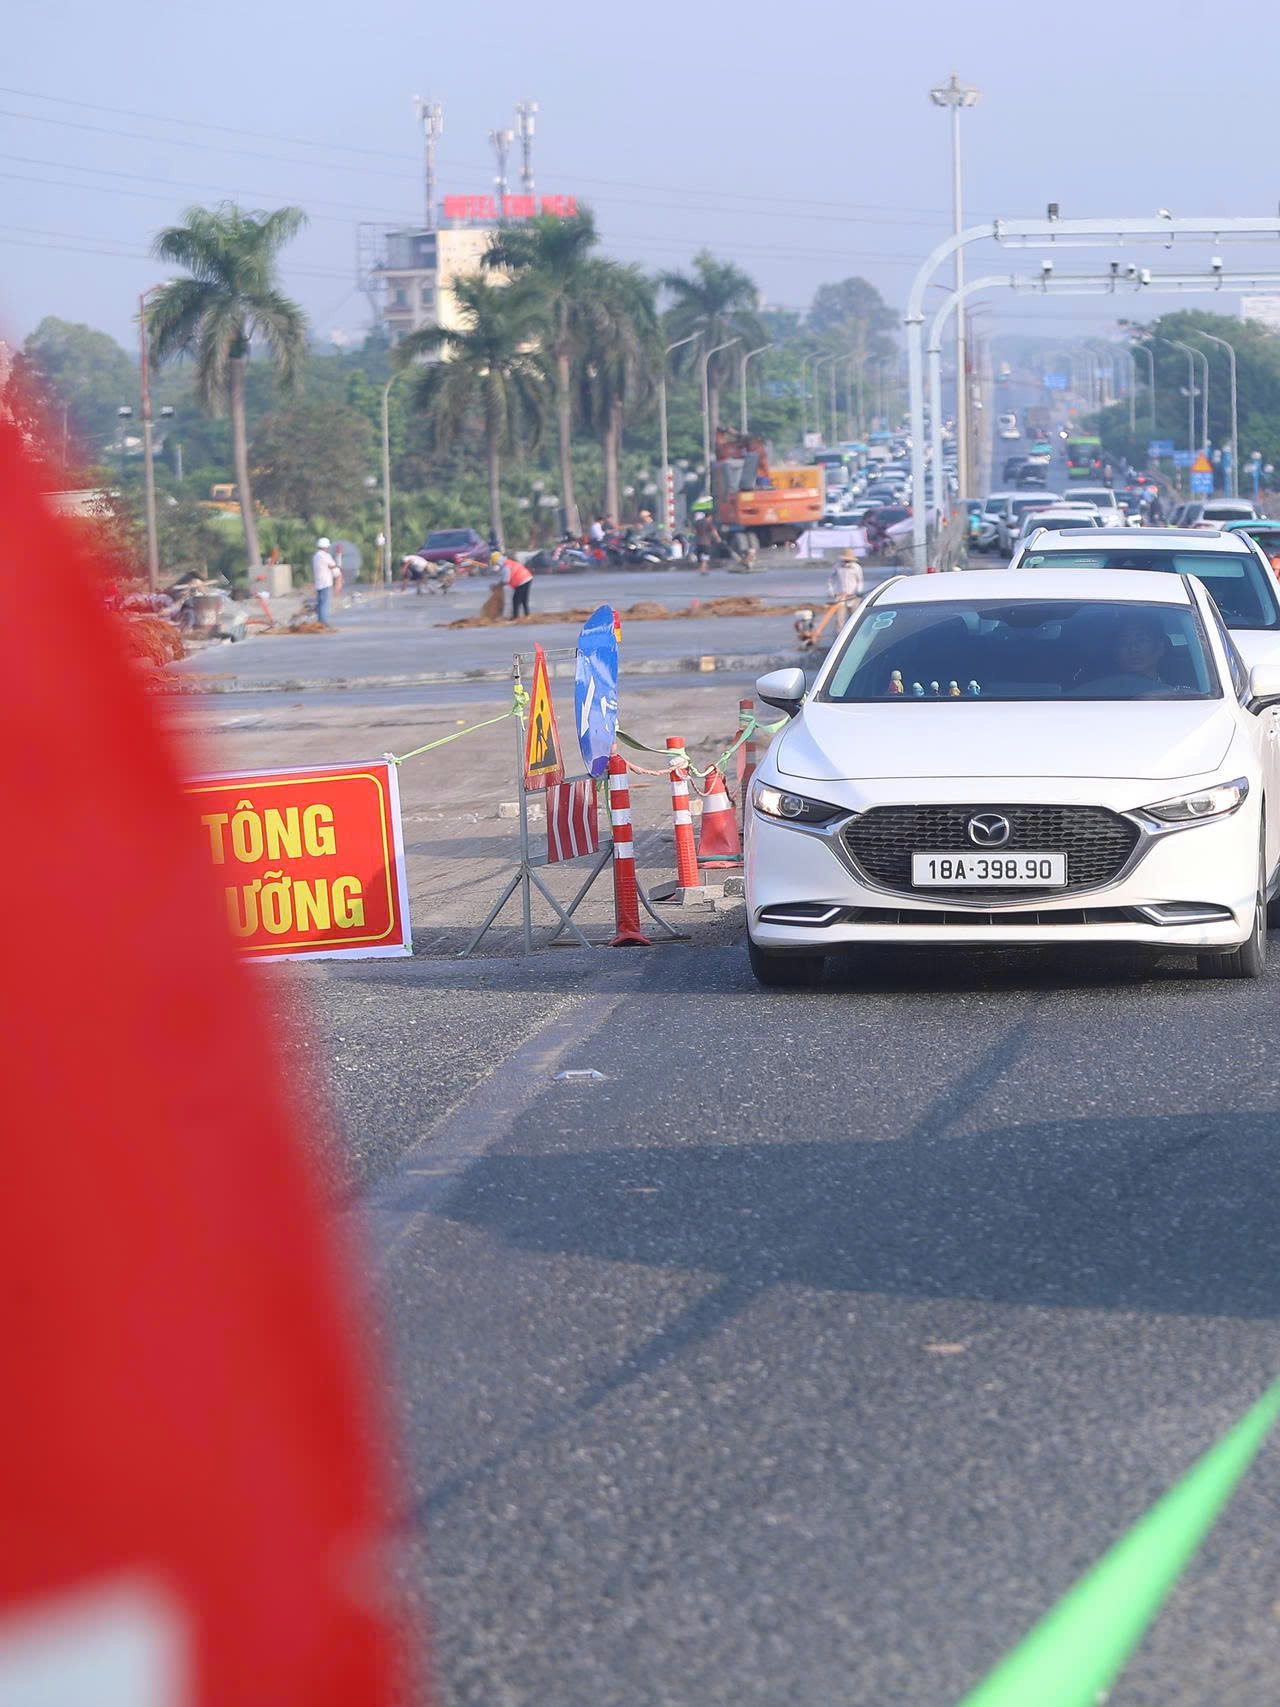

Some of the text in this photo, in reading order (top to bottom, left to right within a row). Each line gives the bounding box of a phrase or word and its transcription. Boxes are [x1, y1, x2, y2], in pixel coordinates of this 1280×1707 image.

[201, 799, 337, 865] TÔNG
[928, 859, 1052, 880] 18A-398.90
[225, 870, 366, 938] ƯỠNG
